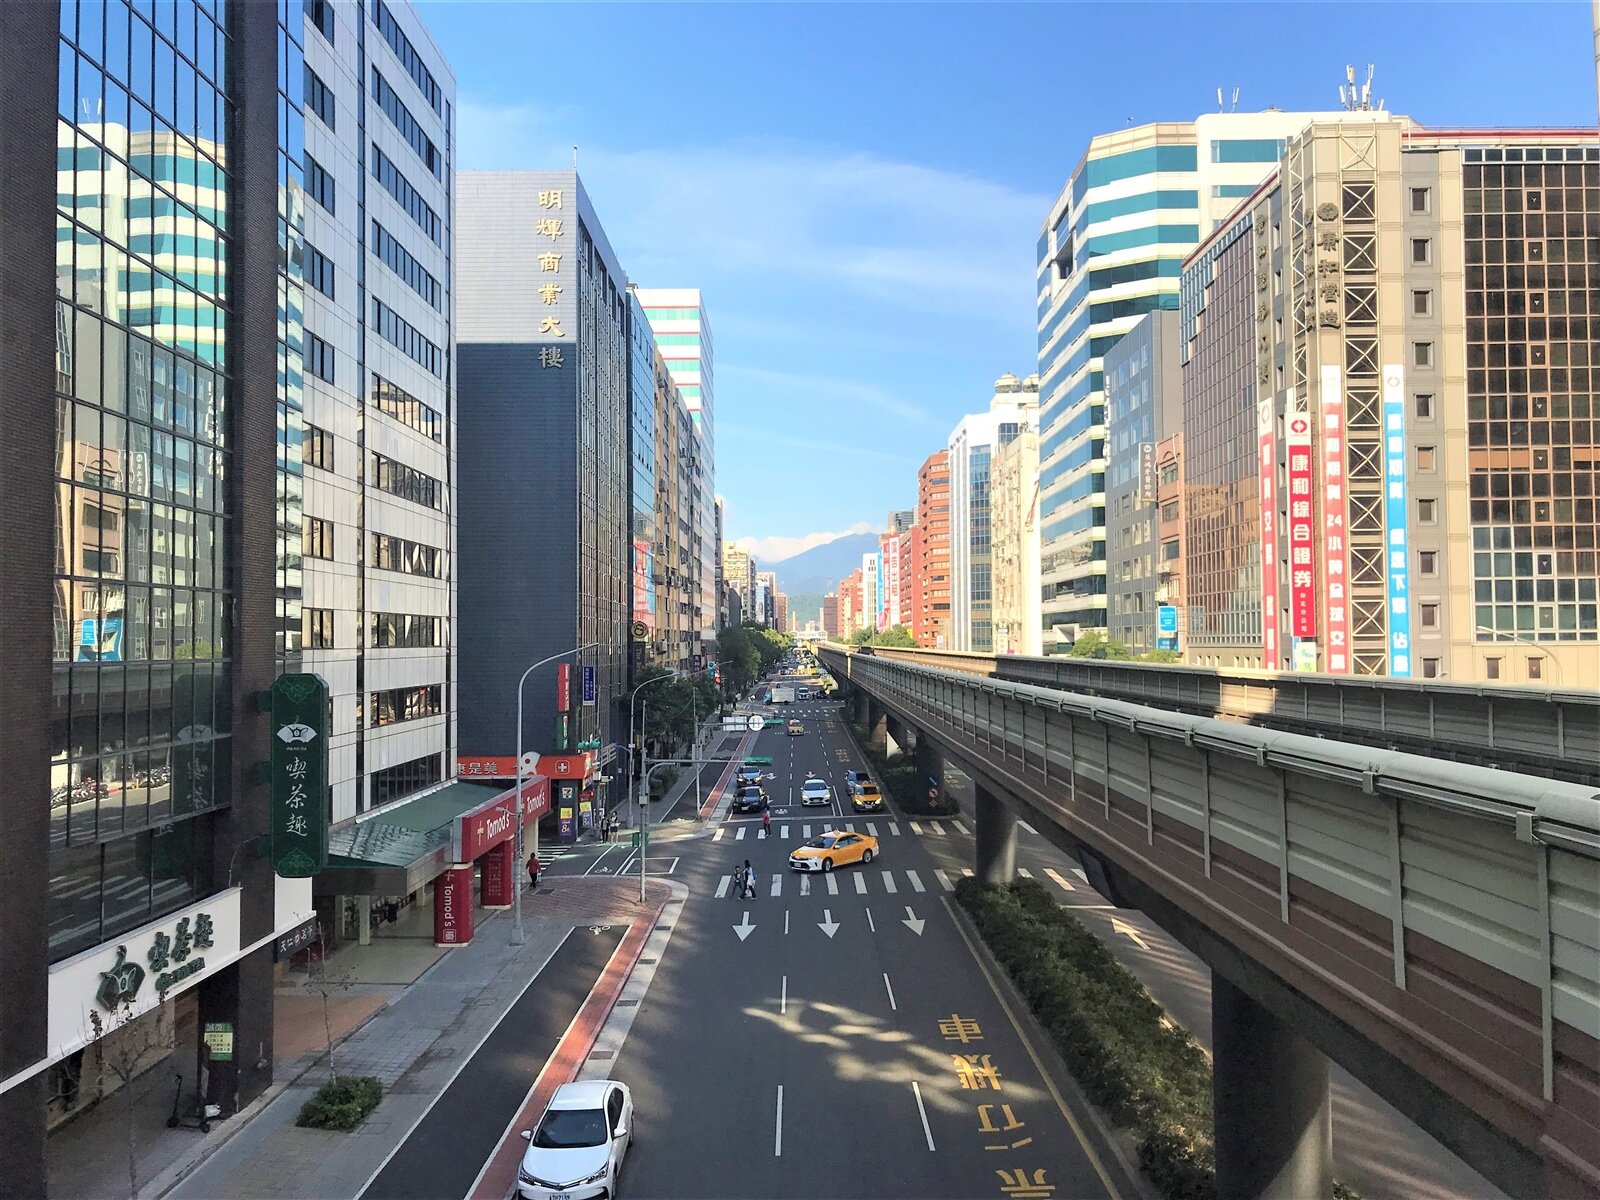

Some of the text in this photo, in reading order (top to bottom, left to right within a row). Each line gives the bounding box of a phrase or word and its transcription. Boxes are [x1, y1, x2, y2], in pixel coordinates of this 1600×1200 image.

[536, 188, 565, 369] 明輝商業大樓
[1291, 454, 1311, 588] 康和綜合證券
[285, 756, 308, 838] 喫茶趣
[486, 803, 510, 839] Tomod's
[526, 785, 545, 815] Tomod's
[444, 884, 456, 927] Tomod's
